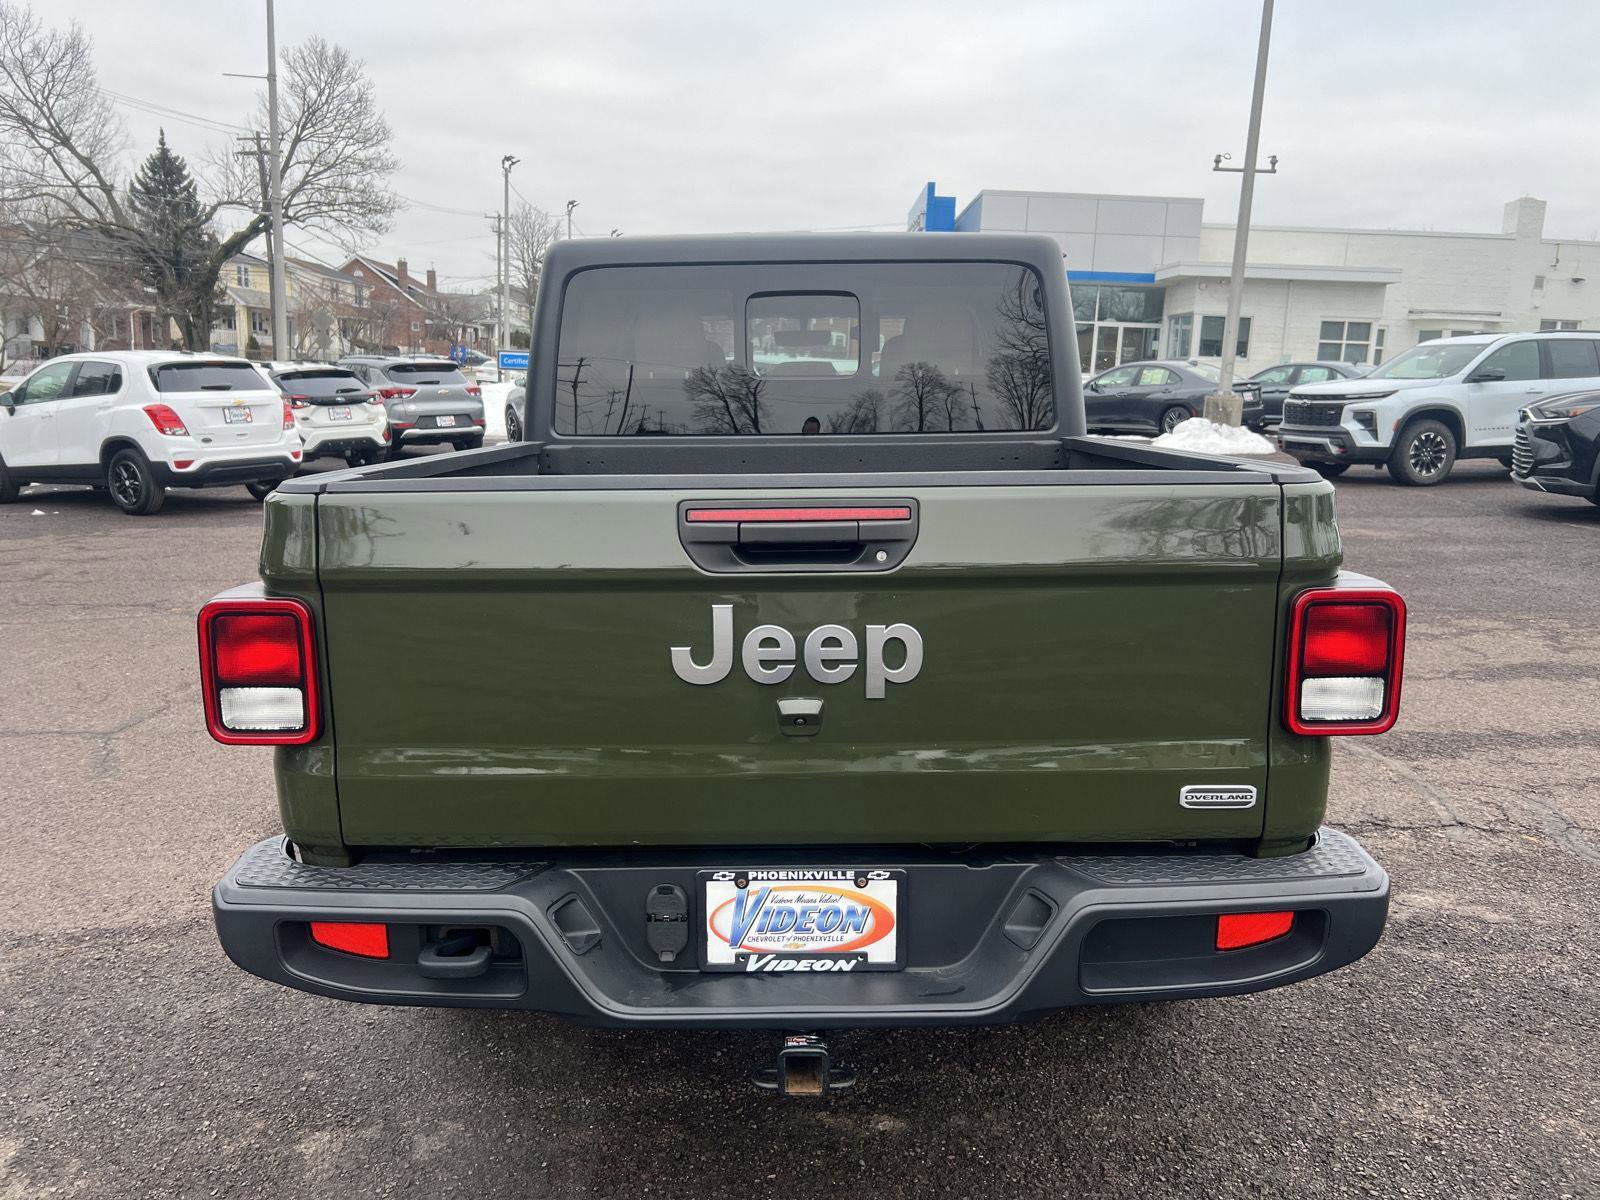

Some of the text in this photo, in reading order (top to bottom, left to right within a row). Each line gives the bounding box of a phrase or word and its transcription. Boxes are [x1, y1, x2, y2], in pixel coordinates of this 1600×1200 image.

[670, 604, 924, 699] Jeep
[748, 871, 855, 880] PHOENIXVILLE
[729, 886, 872, 949] VIDEON
[747, 935, 785, 943] CHEVROLET
[746, 953, 858, 972] VIDEON
